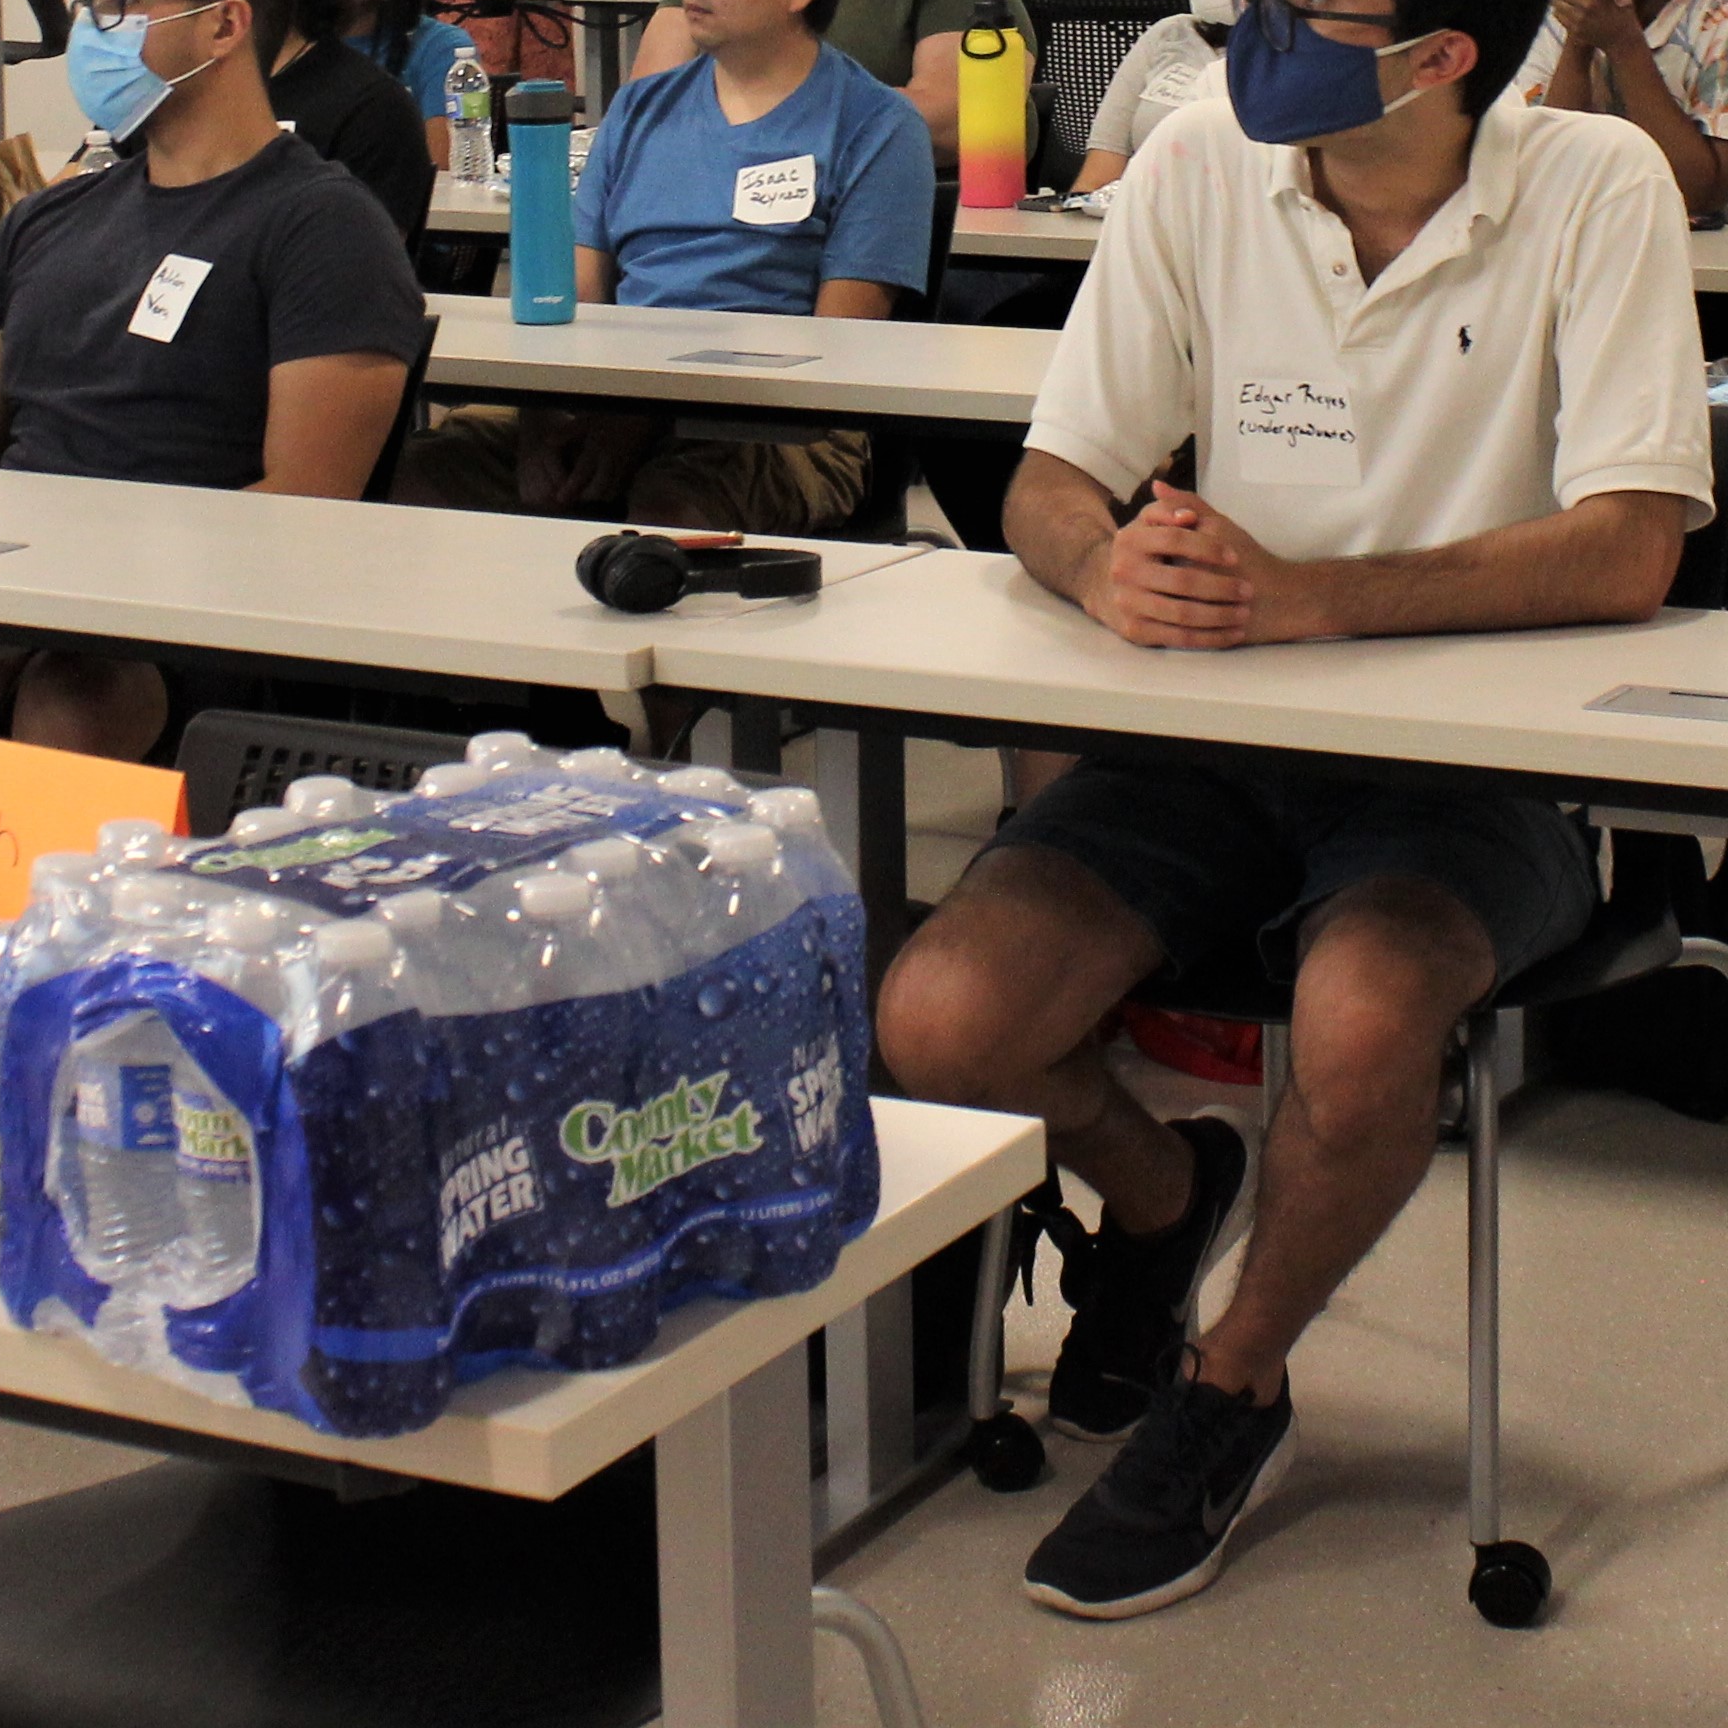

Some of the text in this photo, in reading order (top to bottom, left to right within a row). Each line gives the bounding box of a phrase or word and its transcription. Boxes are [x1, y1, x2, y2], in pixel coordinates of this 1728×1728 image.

[1239, 383, 1347, 415] Edgar Reyes
[559, 1070, 730, 1164] County
[605, 1098, 767, 1208] Market
